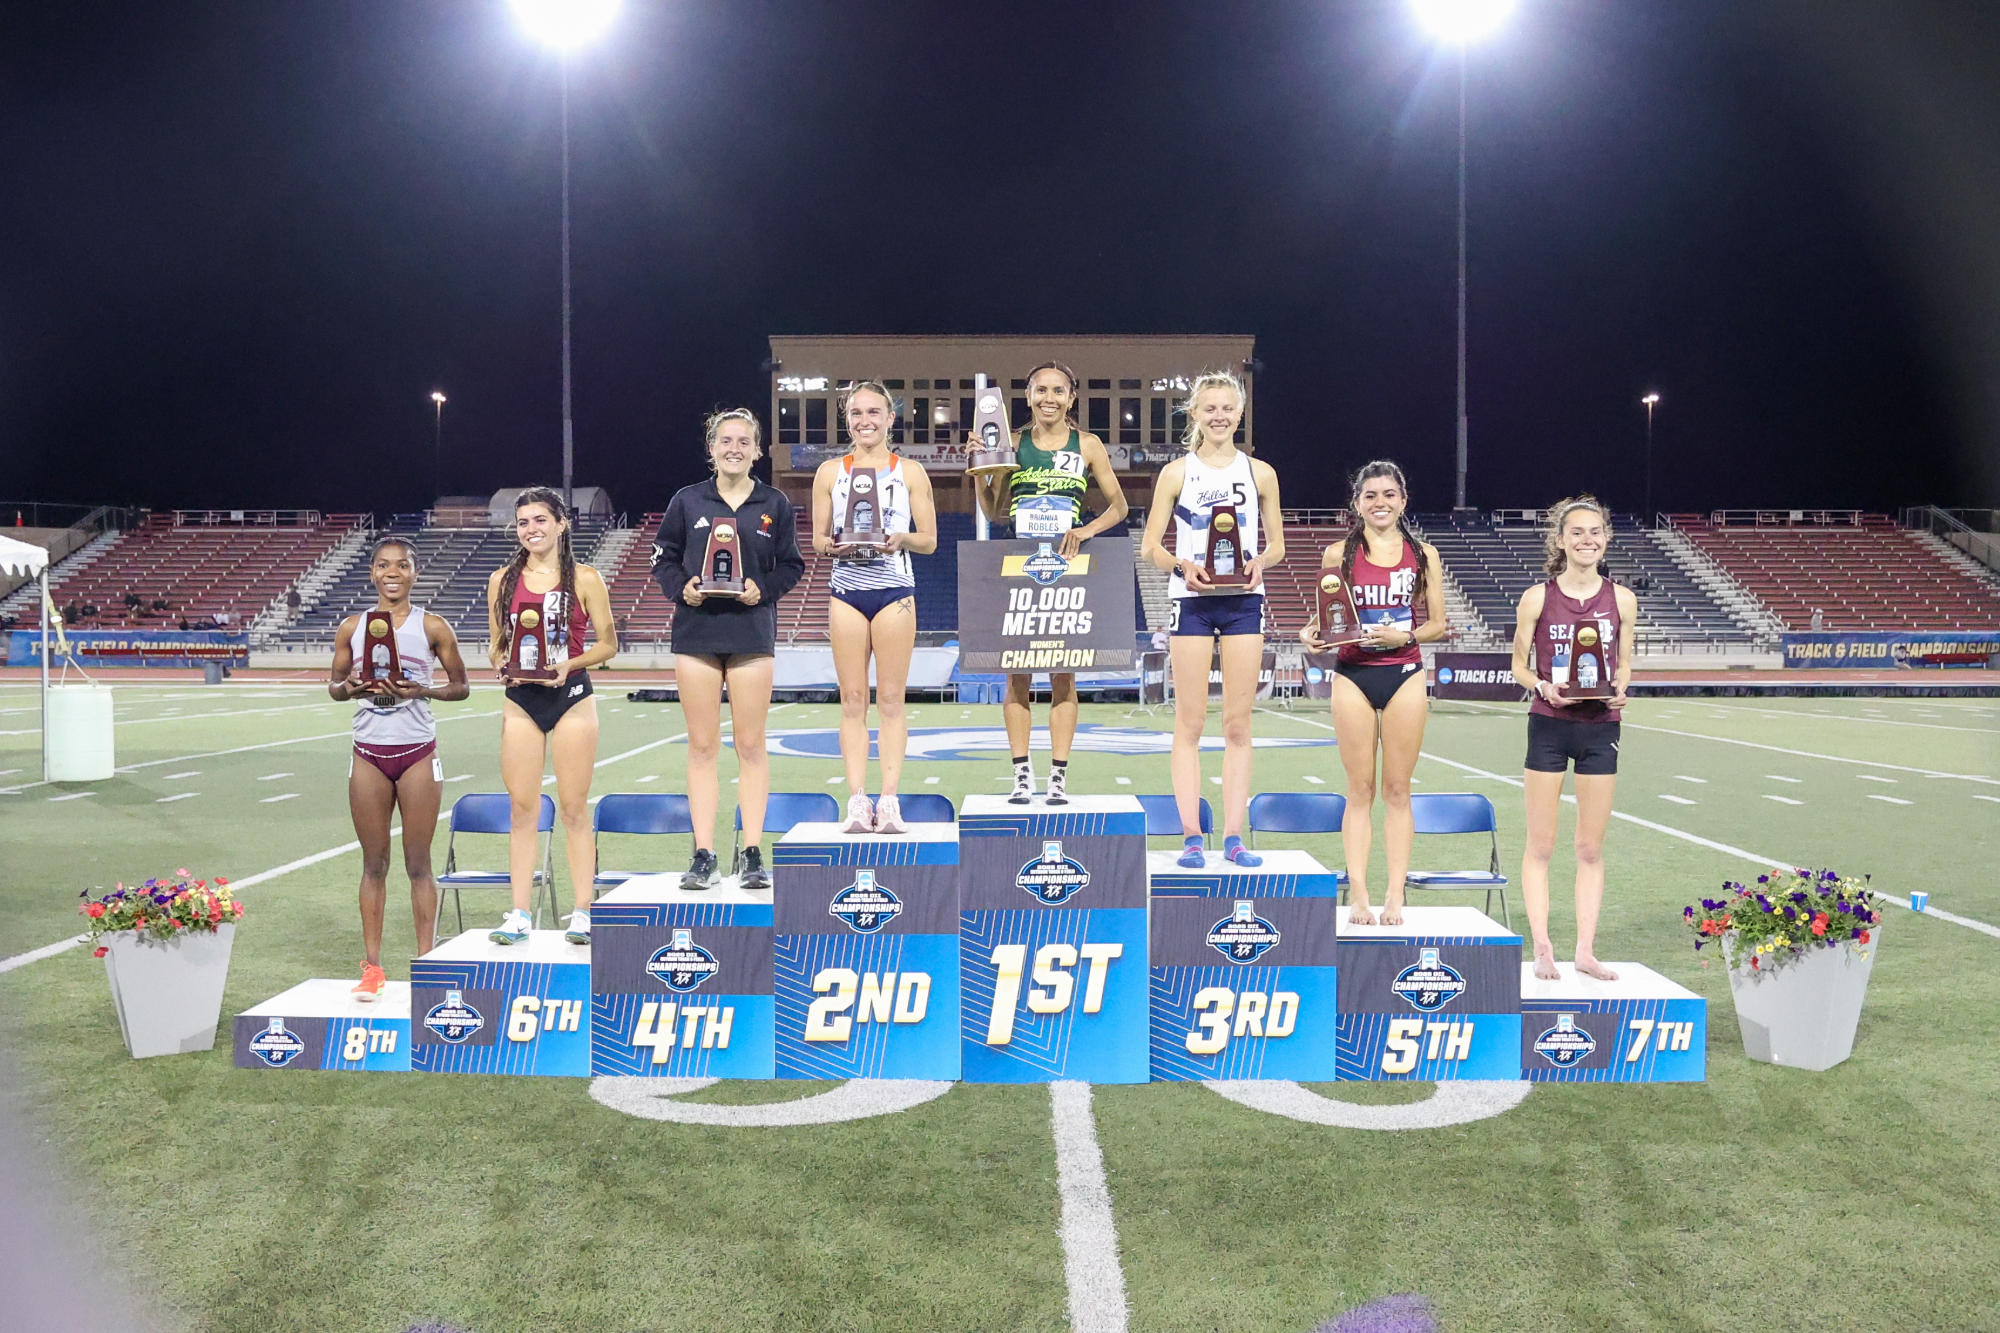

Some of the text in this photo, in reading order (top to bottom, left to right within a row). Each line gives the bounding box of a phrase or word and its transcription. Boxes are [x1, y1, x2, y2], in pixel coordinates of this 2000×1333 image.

[1060, 453, 1080, 473] 21
[885, 484, 894, 507] 1
[1036, 477, 1077, 495] State
[1232, 483, 1246, 506] 5
[1029, 513, 1058, 521] BRIANNA
[1028, 522, 1059, 532] ROBLES
[1023, 564, 1069, 572] CHAMPIONSHIPS
[1396, 573, 1415, 594] 18
[1008, 586, 1086, 613] 10,000
[1002, 611, 1093, 636] METERS
[1030, 640, 1065, 649] WOMEN'S
[1787, 641, 2000, 659] TRACK & FIELD CAMPIONSHIP
[1001, 649, 1095, 669] CHAMPION
[1454, 669, 1487, 683] TRACK
[1487, 670, 1496, 684] &
[1496, 670, 1517, 684] FIE
[373, 696, 396, 707] ADDO
[1018, 875, 1088, 884] CHAMPIONSHIPS
[832, 903, 900, 913] CHAMPIONSHIPS
[1208, 934, 1278, 943] CHAMPIONSHIPS
[649, 962, 717, 971] CHAMPIONSHIPS
[986, 943, 1123, 1045] 1ST
[1394, 982, 1464, 991] CHAMPIONSHIPS
[804, 968, 932, 1042] 2ND
[426, 1018, 482, 1026] CHAMPIONSHIPS
[507, 995, 582, 1042] 6TH
[1185, 987, 1300, 1054] 3RD
[632, 1002, 735, 1064] 4TH
[1627, 1019, 1694, 1062] 7TH
[343, 1027, 398, 1061] 8TH
[1381, 1018, 1475, 1074] 5TH
[1536, 1042, 1594, 1050] CHAMPIONSHIPS
